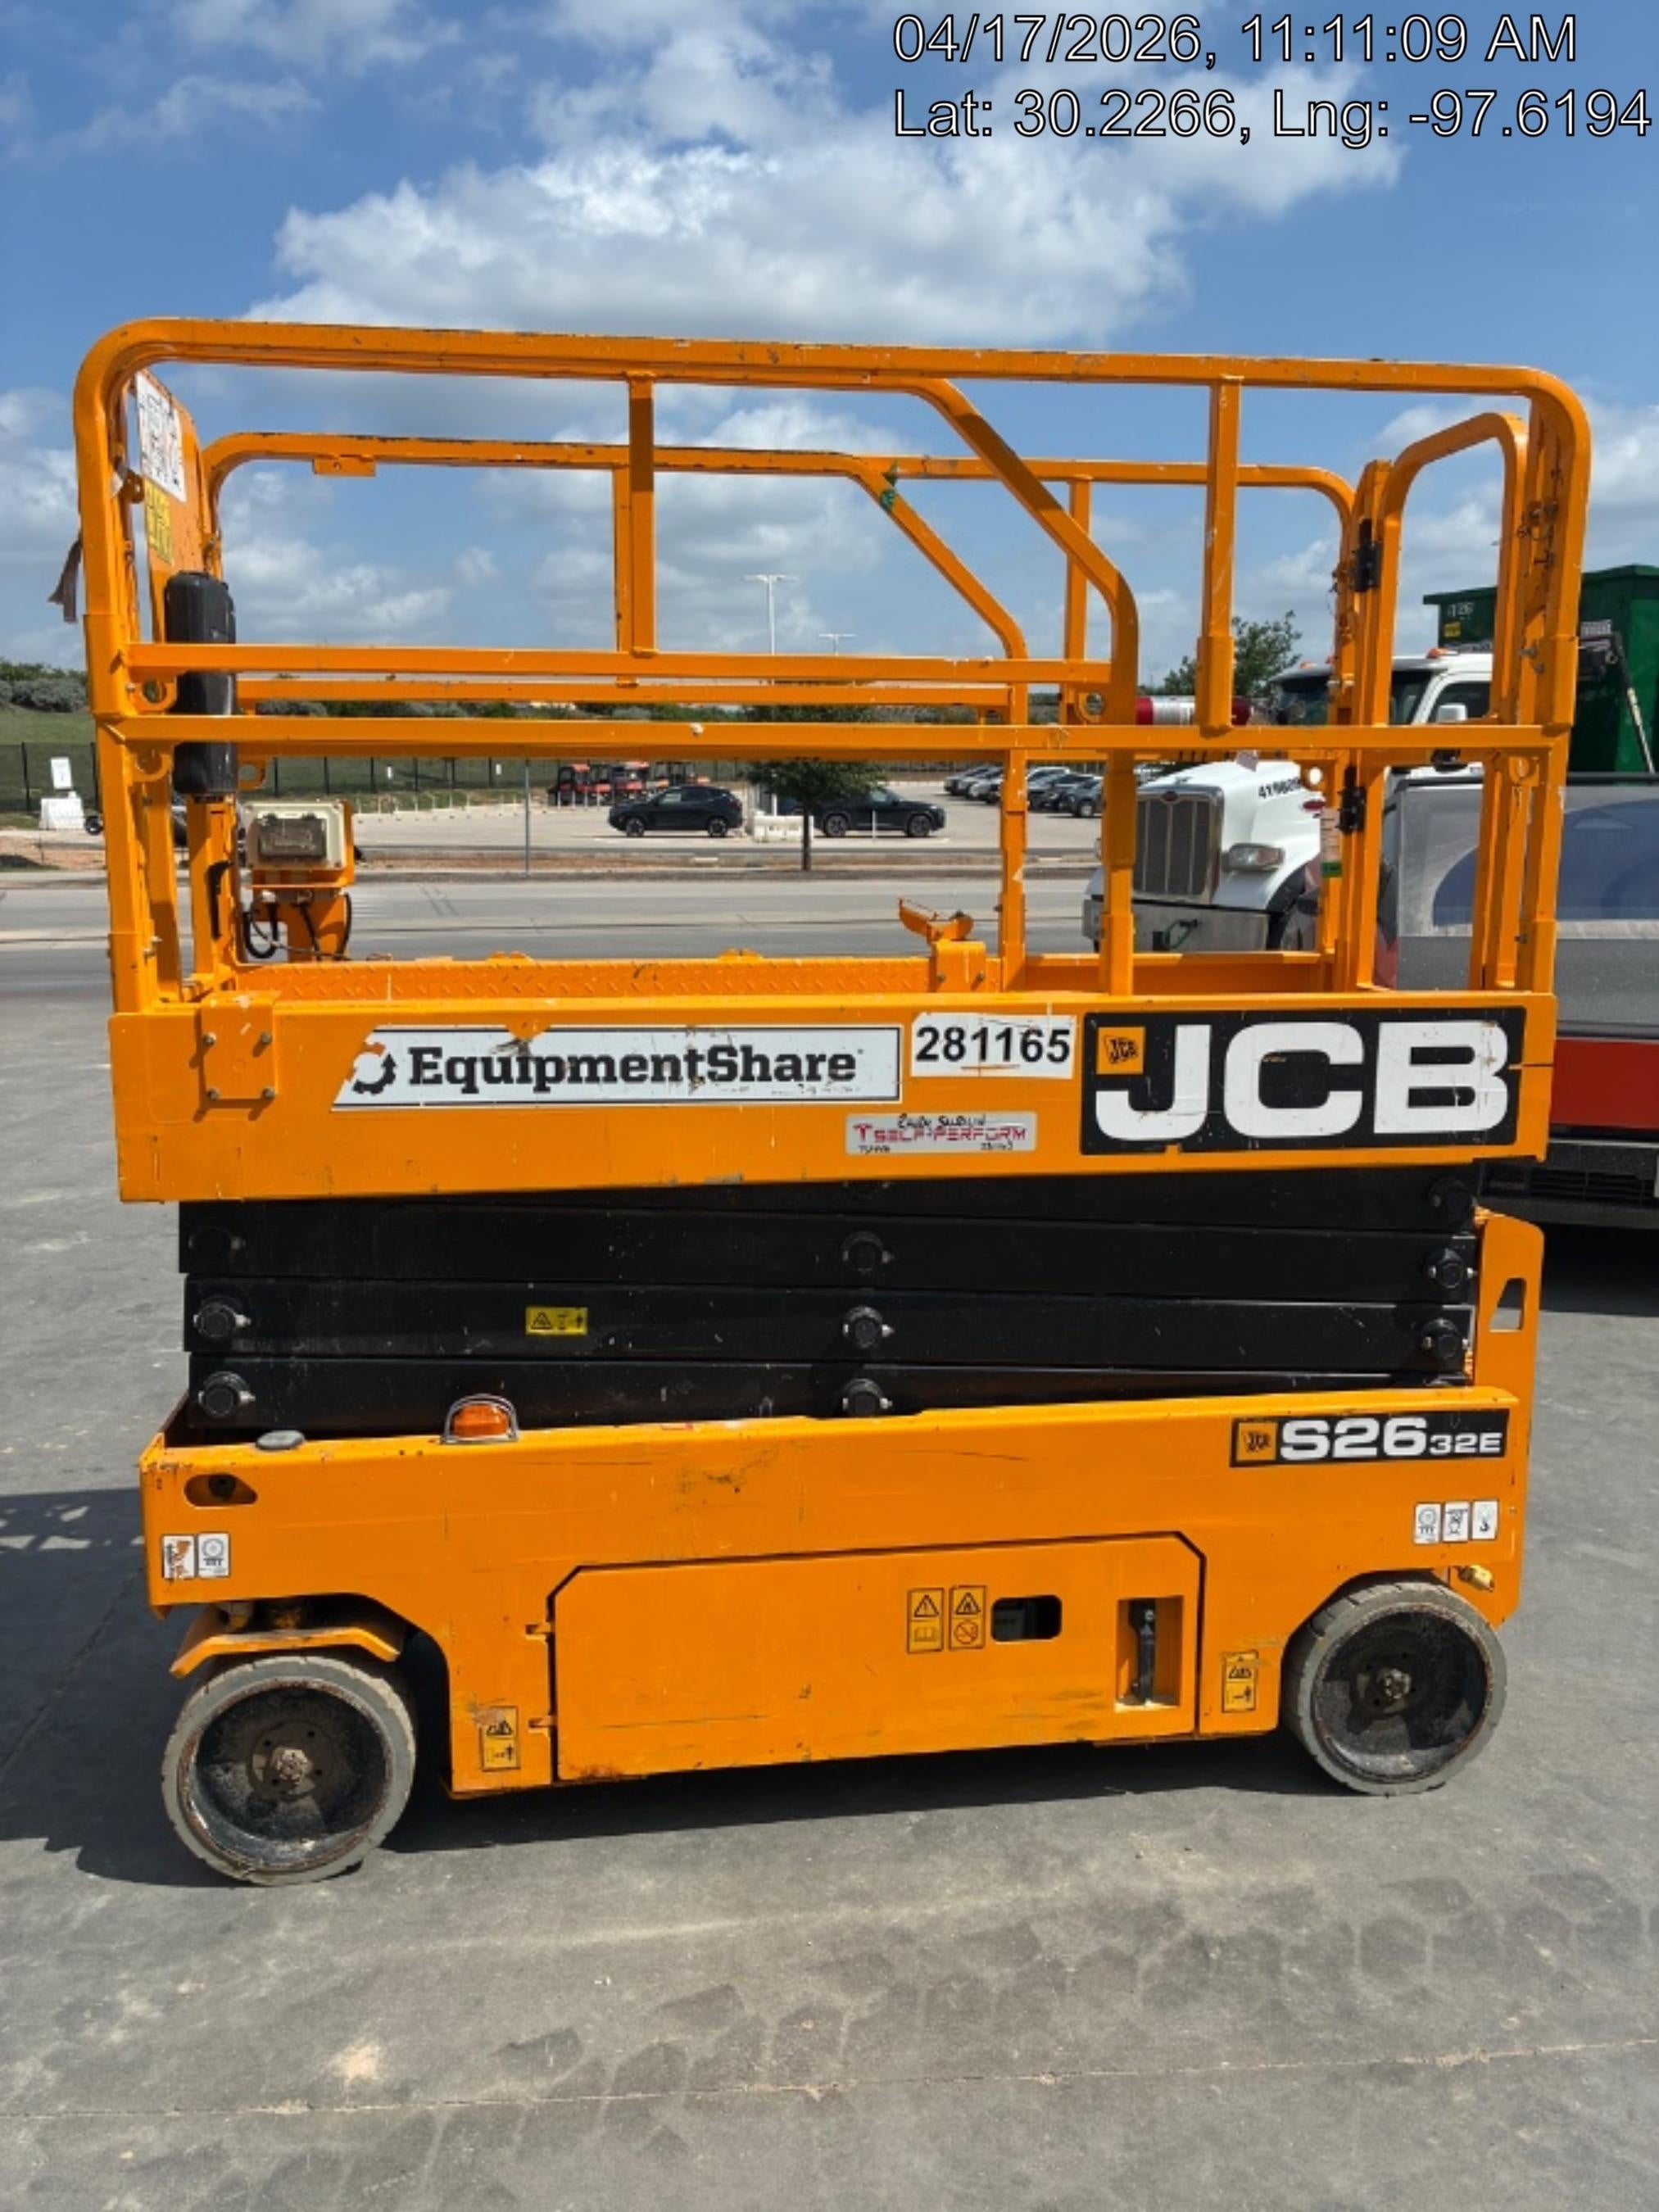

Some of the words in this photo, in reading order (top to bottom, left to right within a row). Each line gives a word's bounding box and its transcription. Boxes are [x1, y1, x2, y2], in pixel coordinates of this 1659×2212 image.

[915, 1027, 1071, 1063] 281165
[408, 1046, 857, 1095] EquipmentShare
[1095, 1022, 1509, 1141] JCB
[1280, 1416, 1427, 1461] S26
[1430, 1432, 1503, 1454] 32E
